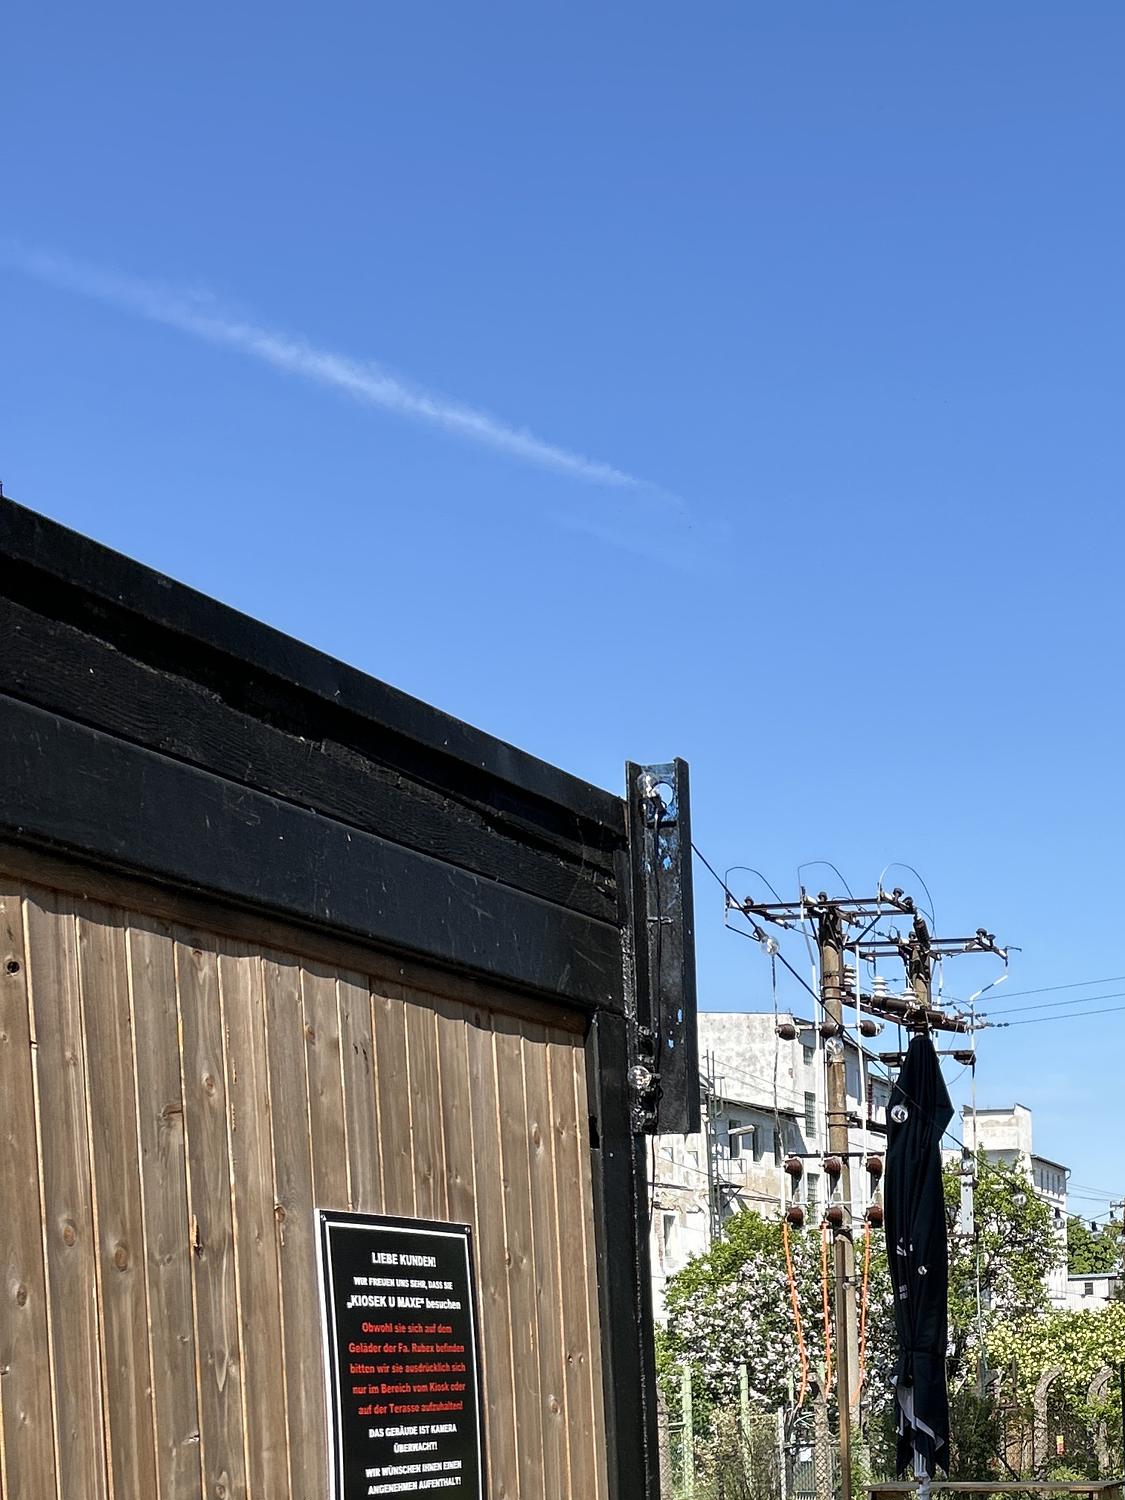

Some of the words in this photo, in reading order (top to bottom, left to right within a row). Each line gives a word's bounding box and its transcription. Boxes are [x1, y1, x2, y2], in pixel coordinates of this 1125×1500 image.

[372, 1252, 398, 1264] LIEBE
[400, 1254, 436, 1267] KUNDEN!
[353, 1277, 368, 1285] WIR
[369, 1277, 395, 1287] FREUEN
[396, 1279, 409, 1288] UNS
[428, 1281, 443, 1289] DASS
[444, 1282, 453, 1290] SIE
[388, 1296, 396, 1307] U
[426, 1298, 461, 1310] besuchen
[362, 1322, 393, 1333] Obwohl
[394, 1323, 406, 1333] sie
[408, 1323, 423, 1333] sich
[425, 1324, 436, 1333] auf
[437, 1324, 452, 1334] dem
[383, 1343, 397, 1353] der
[398, 1343, 410, 1352] Fa.
[436, 1343, 465, 1353] befinden
[350, 1363, 375, 1374] bitten
[376, 1363, 390, 1373] wir
[392, 1363, 403, 1373] sie
[405, 1362, 450, 1373] ausdrücklich
[451, 1362, 466, 1372] sich
[352, 1386, 367, 1394] nur
[368, 1384, 379, 1394] im
[381, 1383, 411, 1394] Bereich
[413, 1384, 428, 1393] vom
[429, 1382, 449, 1392] Kiosk
[450, 1382, 465, 1391] oder
[358, 1405, 372, 1415] auf
[374, 1404, 387, 1414] der
[389, 1403, 420, 1413] Terasse
[368, 1428, 384, 1438] DAS
[385, 1425, 418, 1437] GEBÄUDE
[419, 1425, 430, 1435] IST
[430, 1424, 457, 1434] KAMERA
[393, 1441, 438, 1453] ÜBERWACHT!
[365, 1468, 381, 1478] WIR
[381, 1464, 421, 1476] WÜNSCHEN
[422, 1462, 442, 1472] IHNEN
[443, 1460, 462, 1470] EINEN
[368, 1481, 418, 1495] ANGENEHMEN
[419, 1477, 461, 1490] AUFENTHALT!
